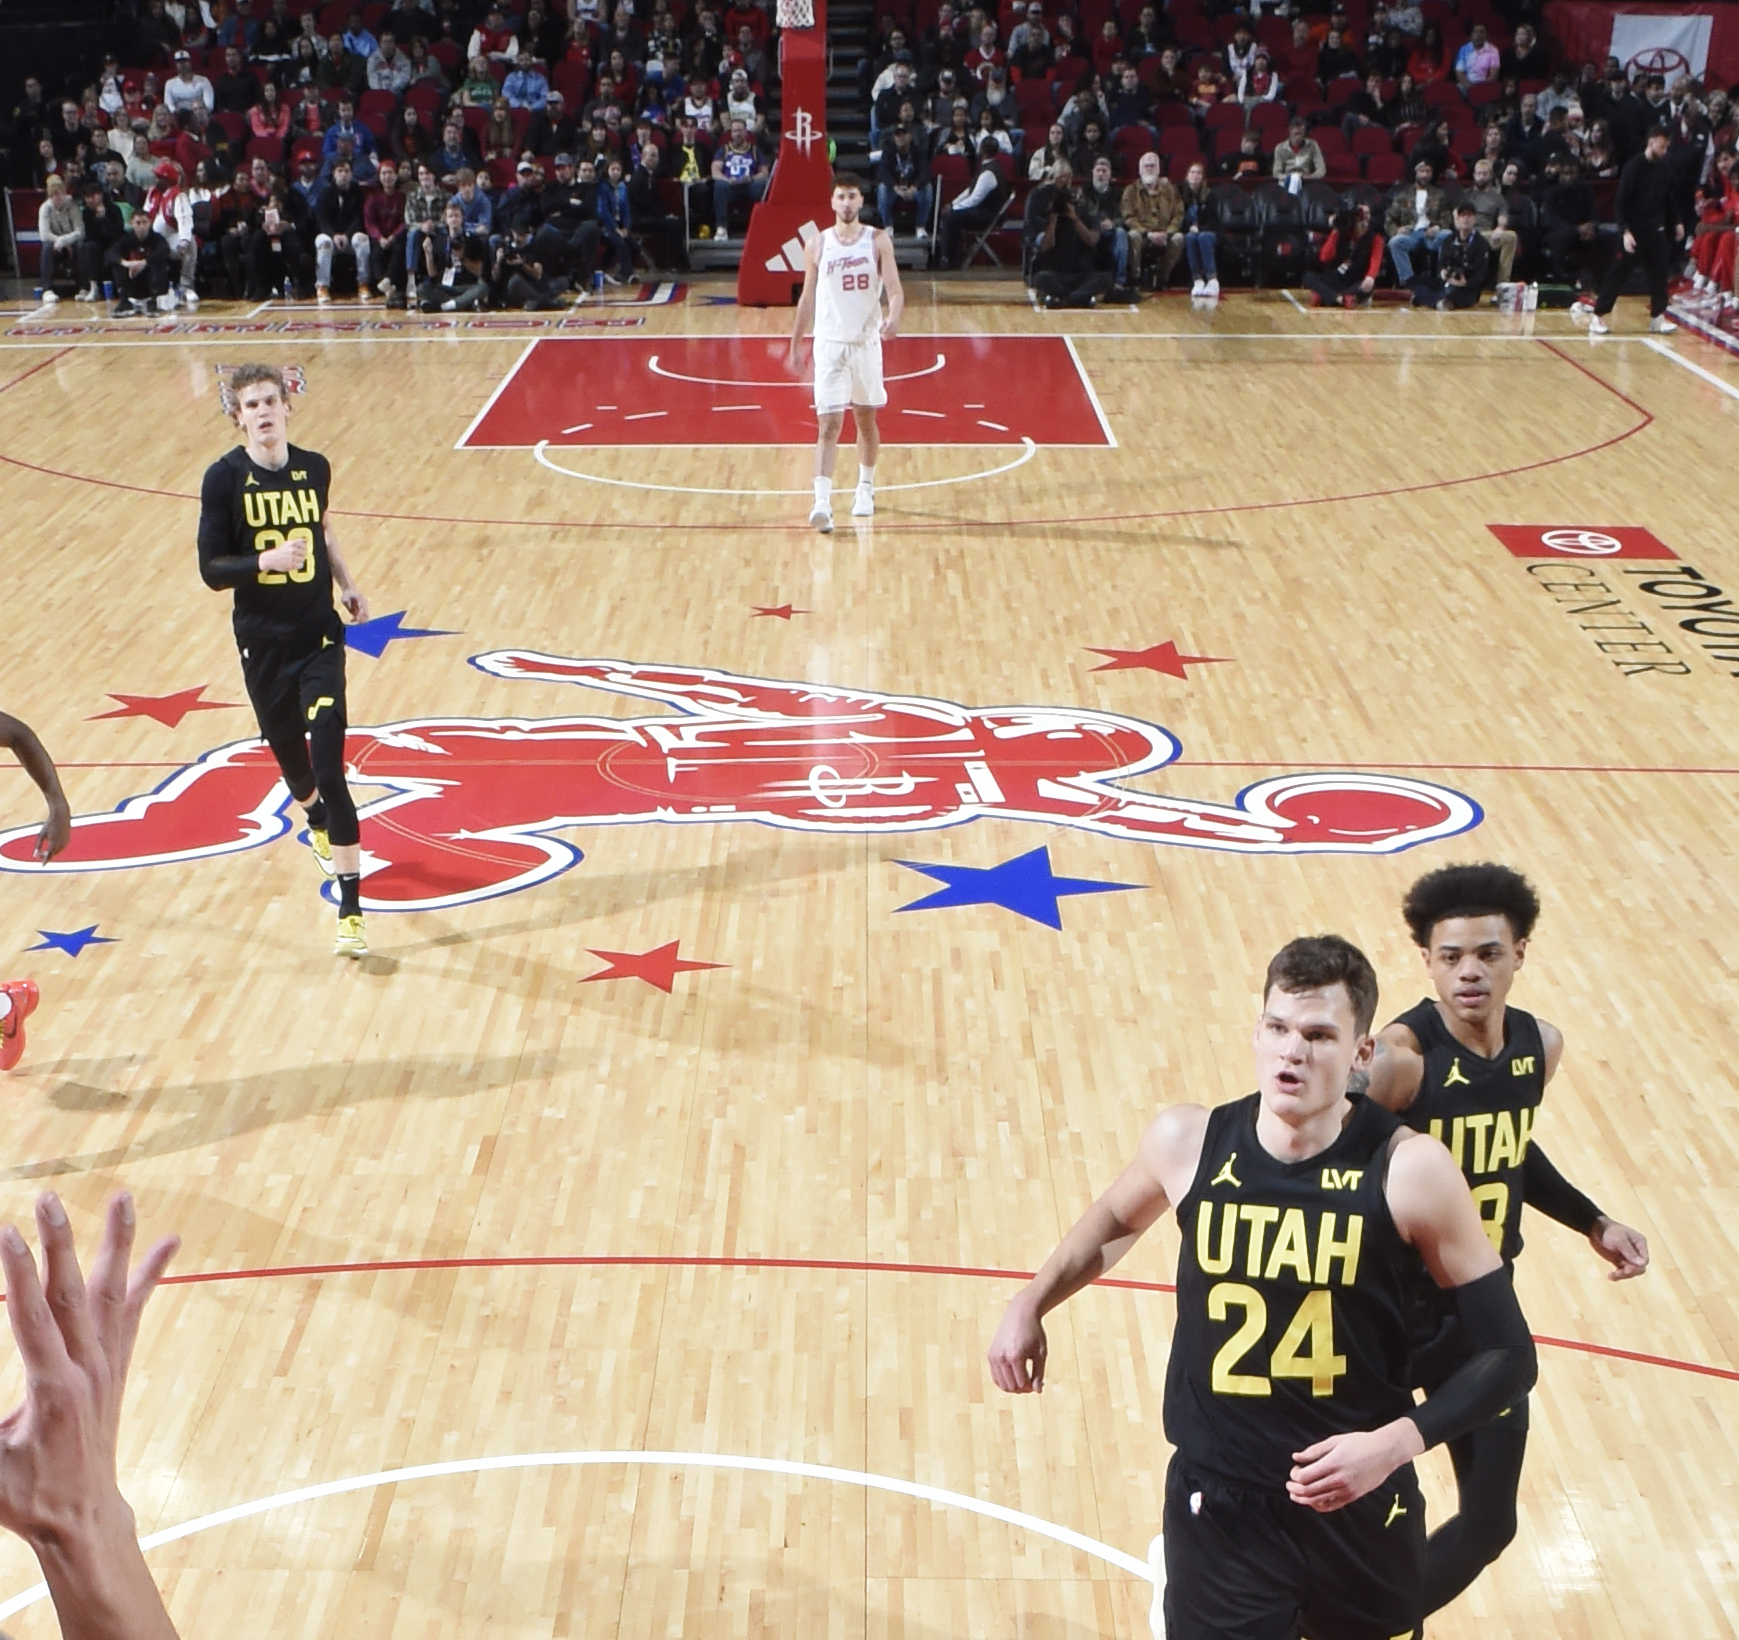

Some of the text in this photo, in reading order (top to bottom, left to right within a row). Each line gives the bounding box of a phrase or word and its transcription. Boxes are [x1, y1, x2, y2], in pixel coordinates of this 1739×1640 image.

[842, 273, 870, 291] 28
[243, 489, 320, 527] UTAH
[1526, 563, 1692, 677] CENTER
[1622, 565, 1739, 678] TOYO
[1512, 1056, 1535, 1077] LVT
[1429, 1105, 1540, 1175] UTAH
[1321, 1168, 1364, 1191] LVT
[1196, 1201, 1364, 1286] UTAH
[1208, 1282, 1348, 1396] 24
